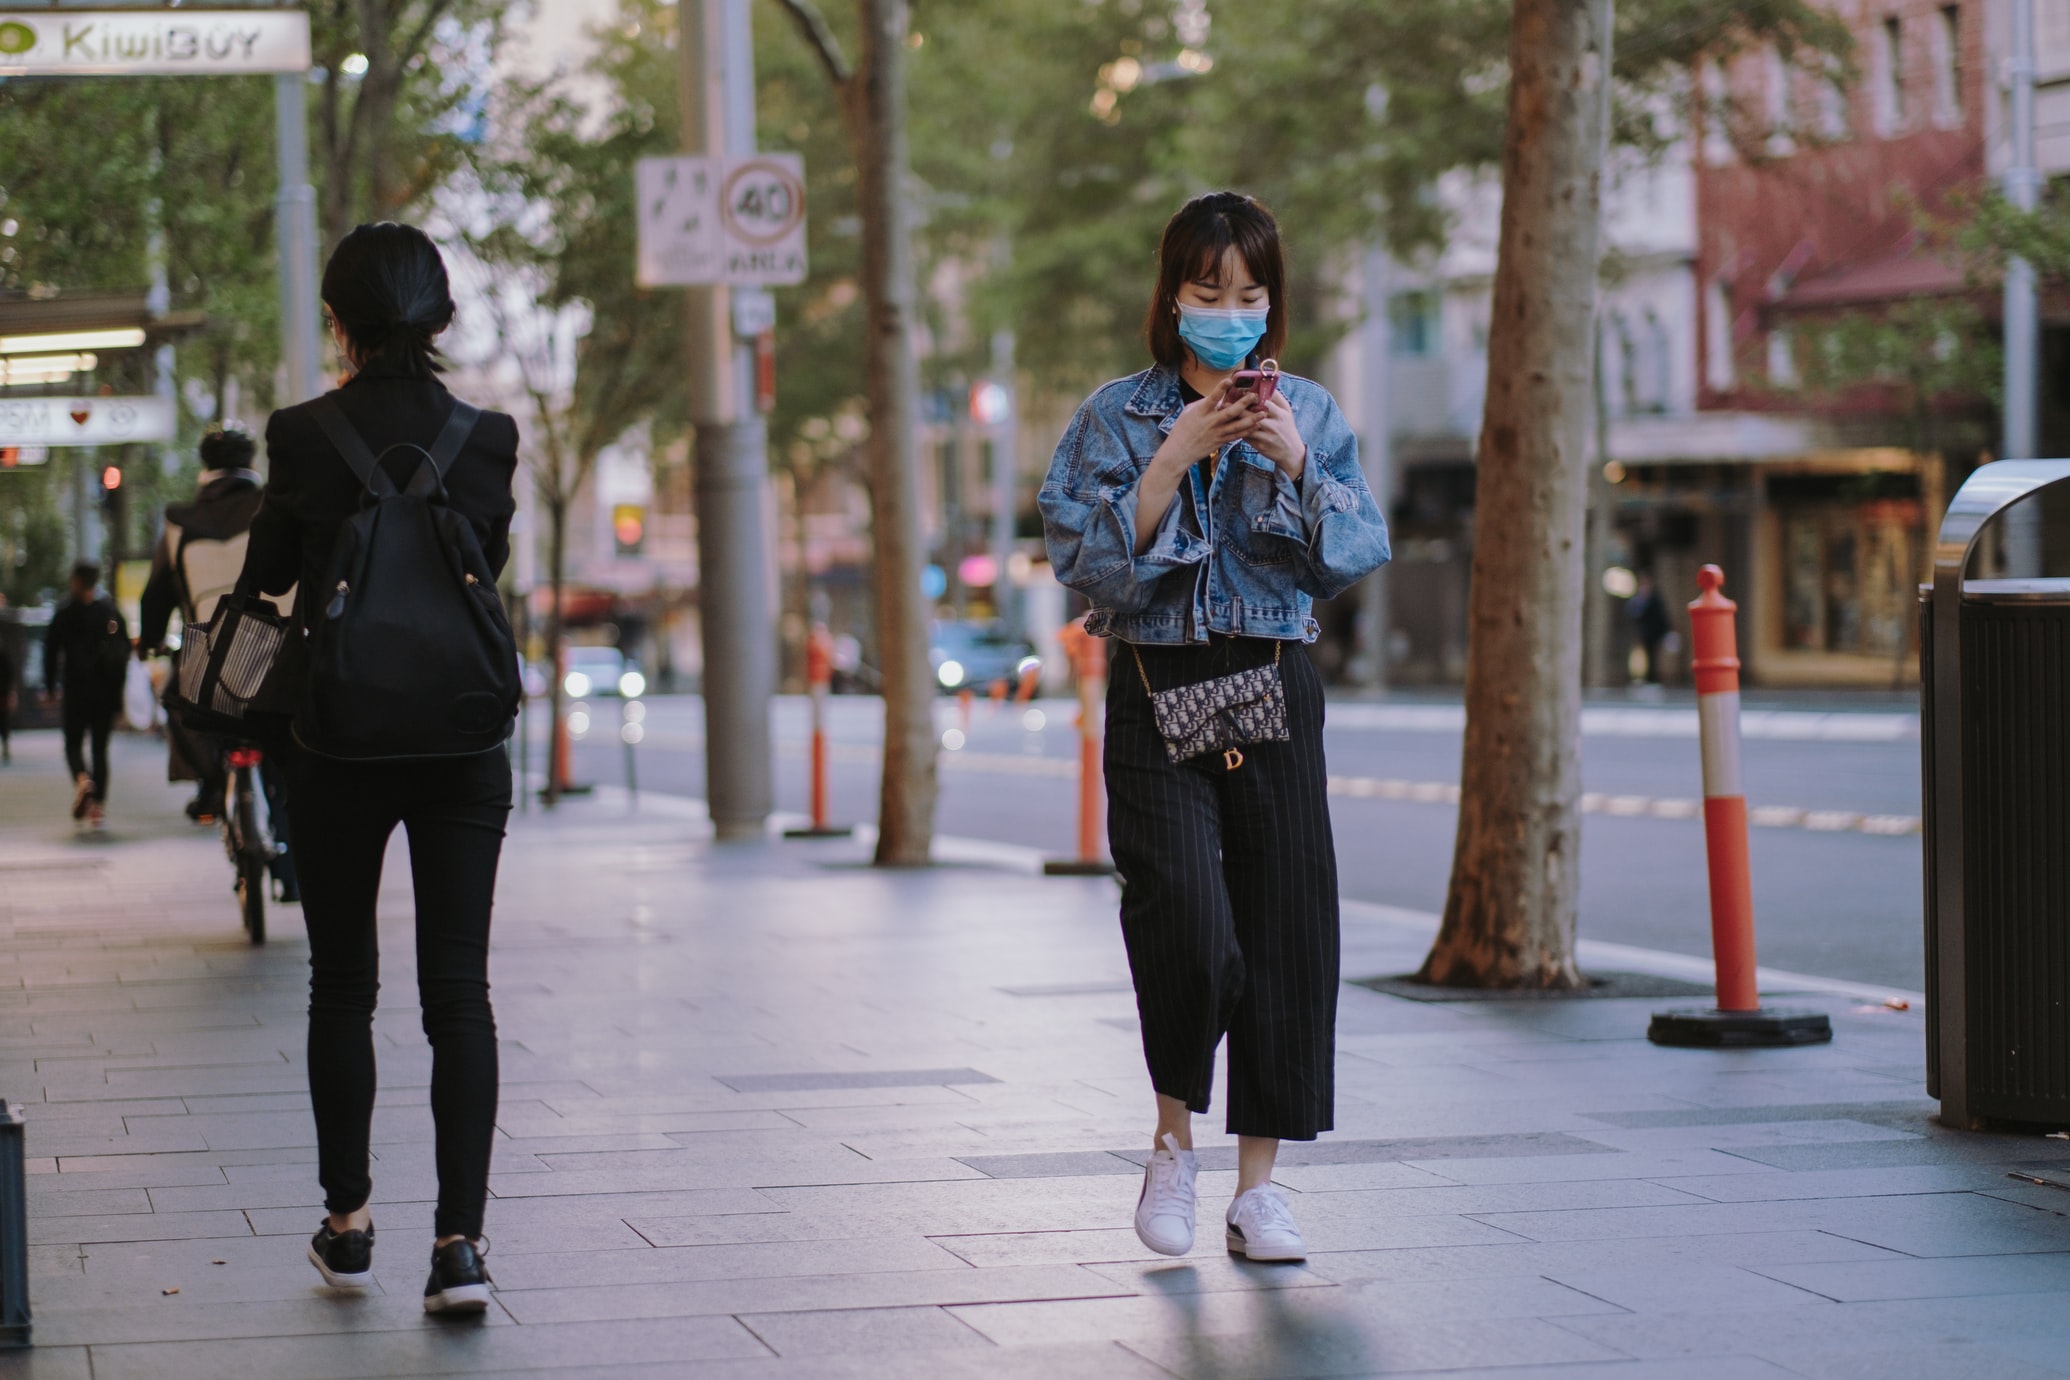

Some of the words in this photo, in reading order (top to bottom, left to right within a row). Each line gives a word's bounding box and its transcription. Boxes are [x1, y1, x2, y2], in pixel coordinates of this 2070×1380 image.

[736, 184, 790, 222] 40
[728, 254, 807, 272] AREA
[1223, 749, 1244, 770] D
